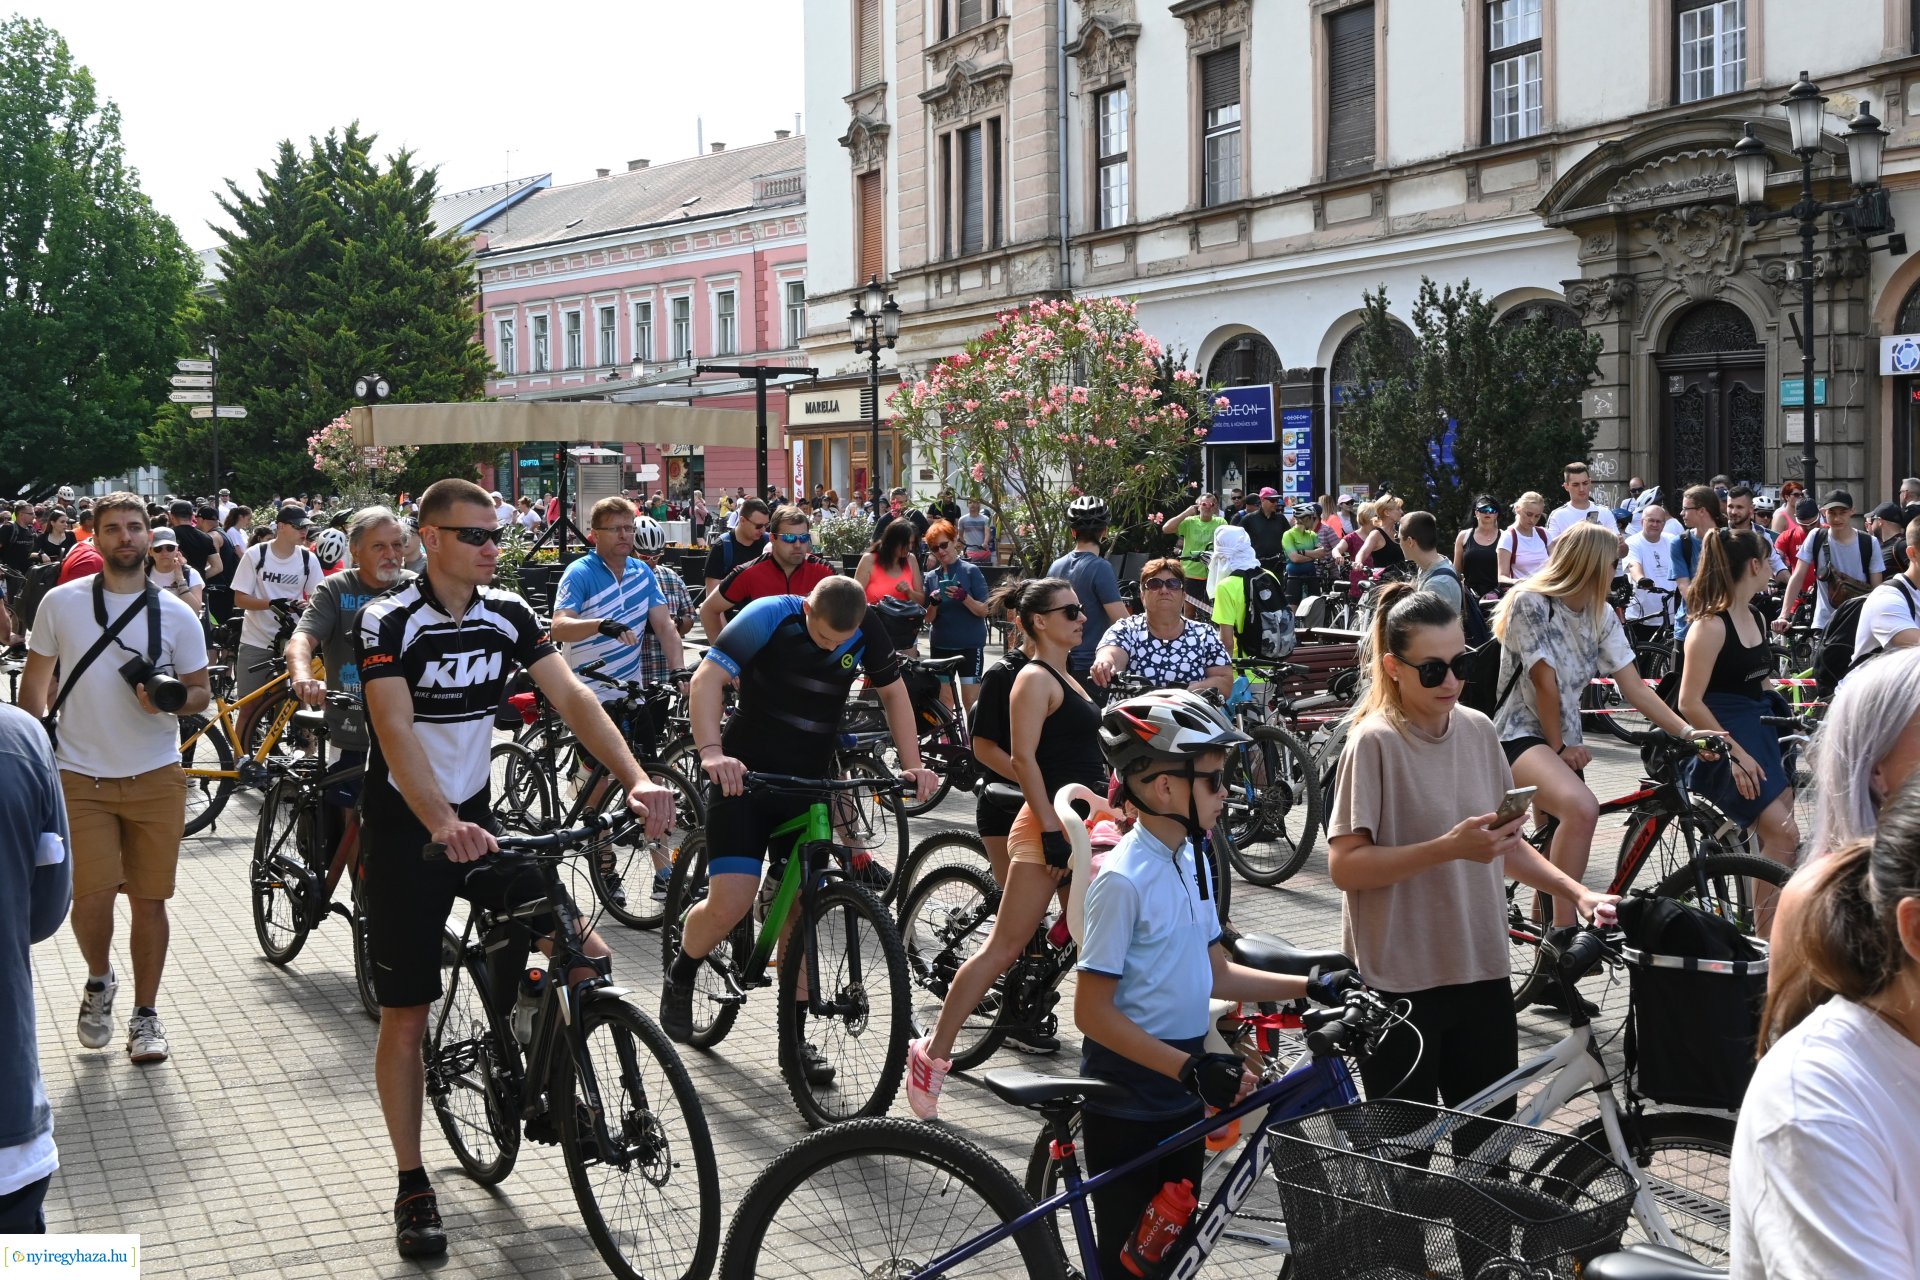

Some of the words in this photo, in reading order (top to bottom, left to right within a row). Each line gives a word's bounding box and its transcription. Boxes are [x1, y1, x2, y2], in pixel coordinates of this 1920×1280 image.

[805, 400, 840, 415] MARELLA
[263, 571, 282, 584] HH
[362, 652, 394, 668] KTM
[416, 648, 503, 689] KTM
[413, 690, 430, 698] BIKE
